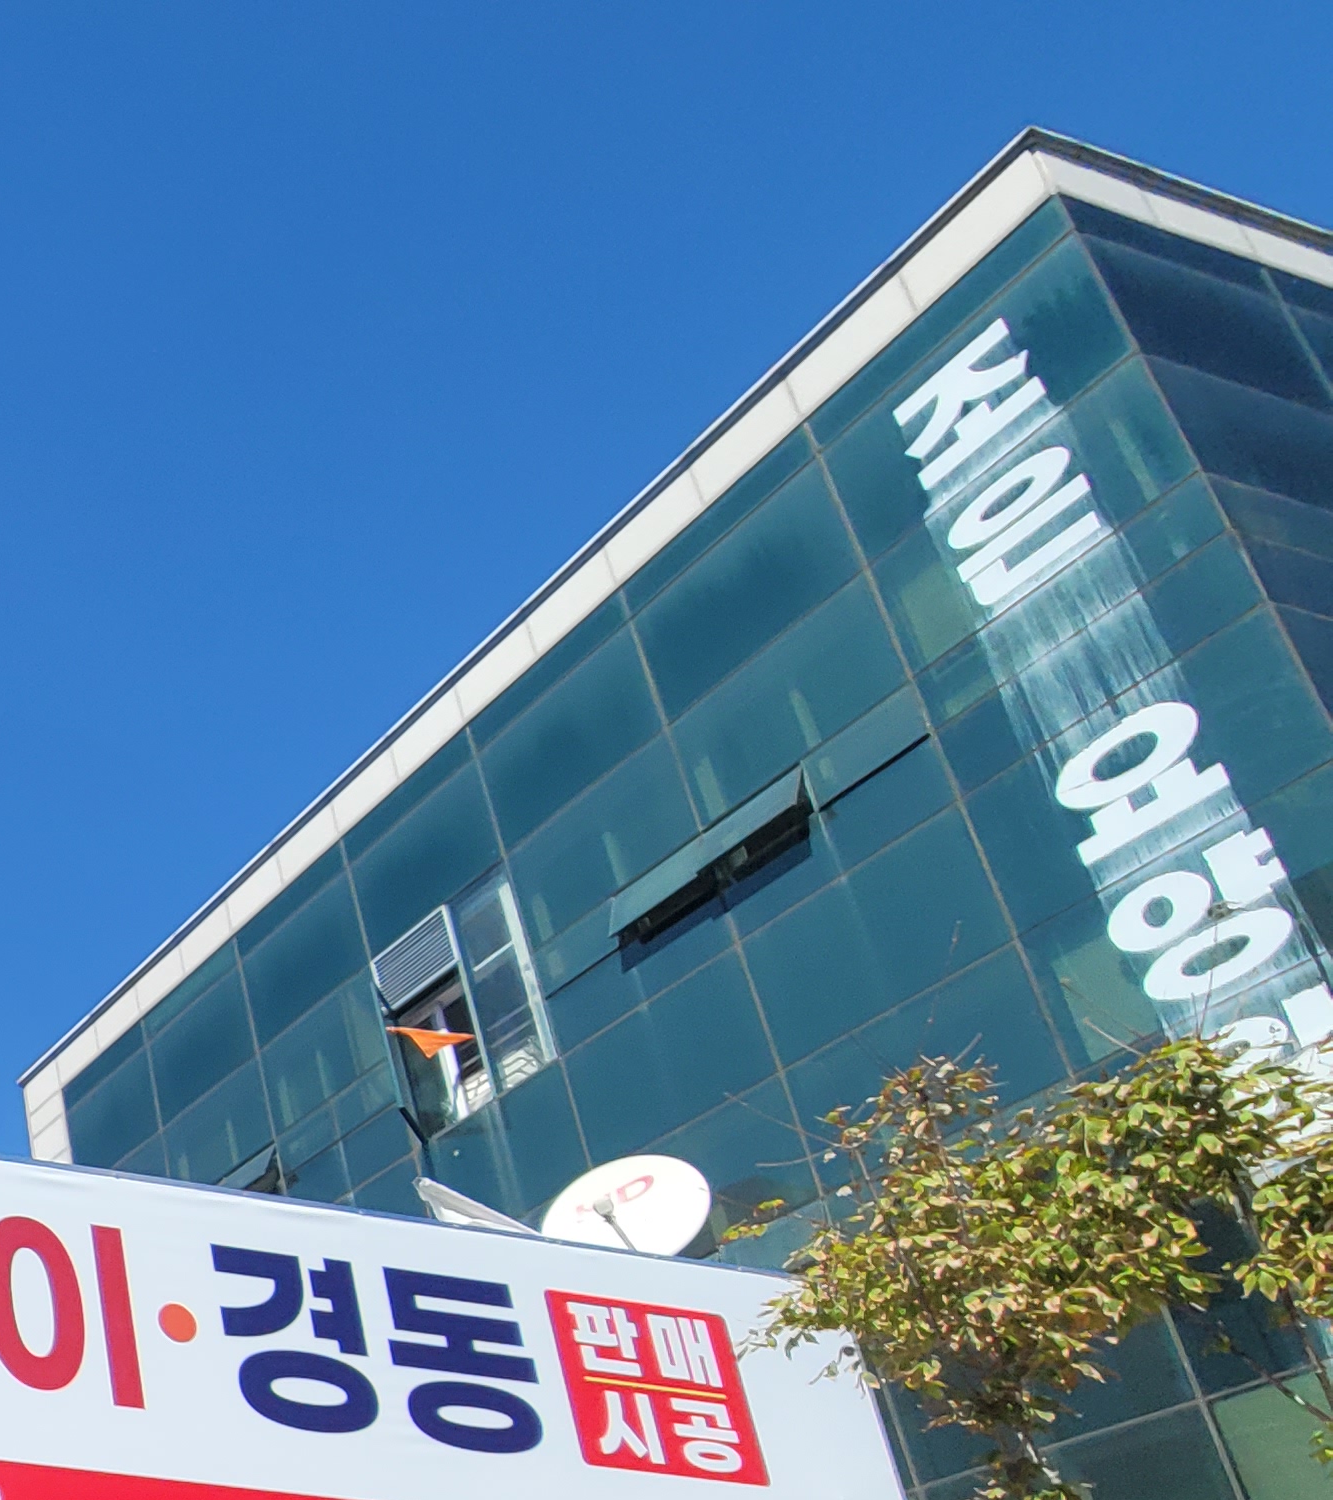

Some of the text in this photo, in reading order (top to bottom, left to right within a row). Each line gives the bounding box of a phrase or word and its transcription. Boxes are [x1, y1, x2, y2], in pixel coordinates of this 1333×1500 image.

[893, 317, 1105, 607] 조은
[210, 1243, 543, 1453] 경동
[566, 1300, 724, 1389] 판매
[600, 1389, 744, 1475] 시공
